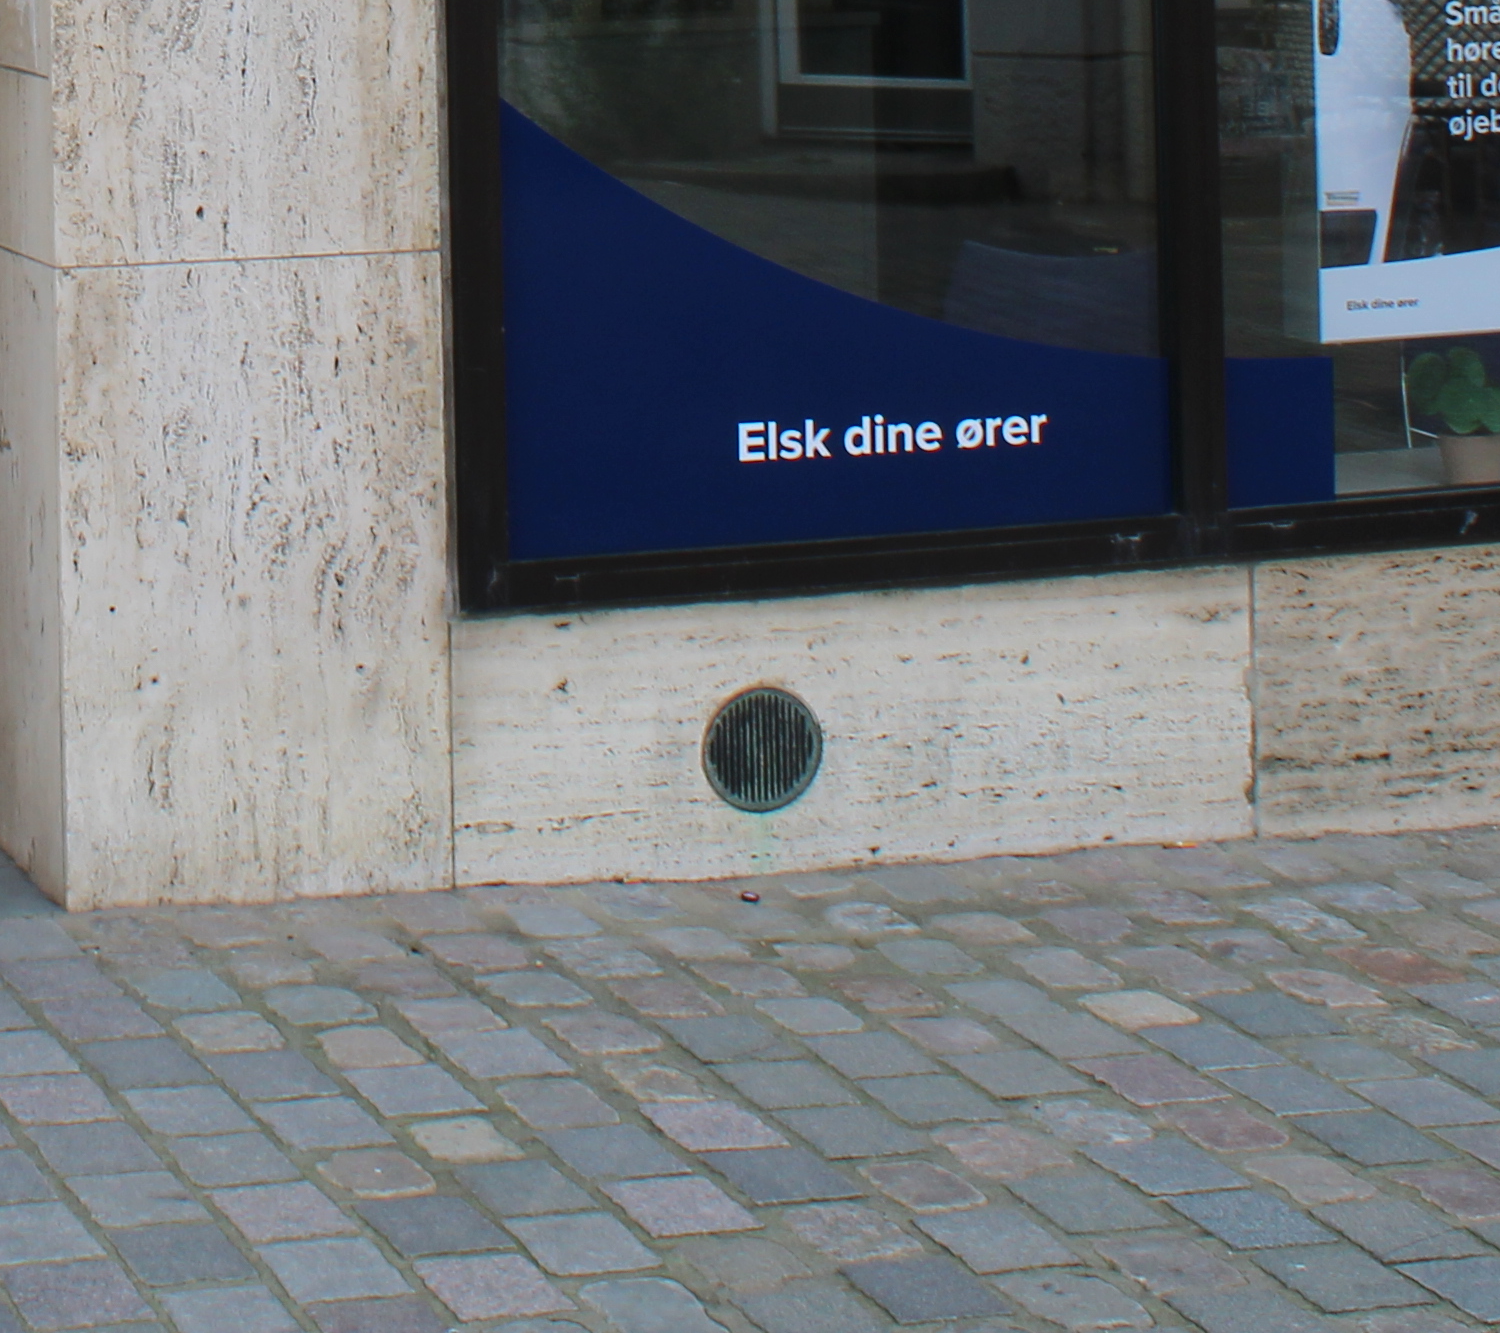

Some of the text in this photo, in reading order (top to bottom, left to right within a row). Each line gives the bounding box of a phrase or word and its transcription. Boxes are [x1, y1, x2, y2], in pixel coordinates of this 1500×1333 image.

[1447, 72, 1472, 99] til
[1346, 299, 1369, 312] Elsk
[1372, 297, 1394, 310] dine
[737, 410, 1048, 463] Elsk dine ører
